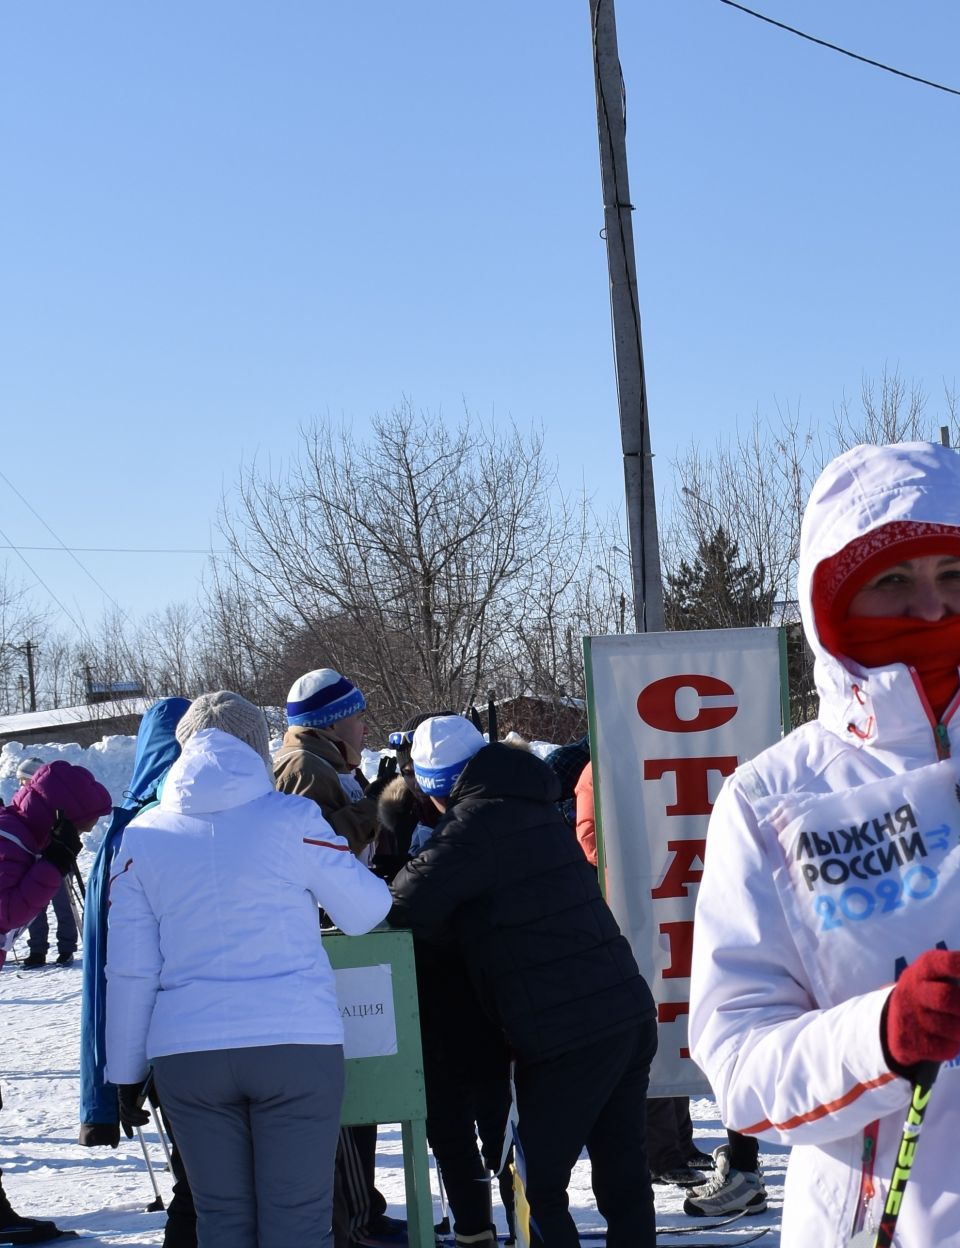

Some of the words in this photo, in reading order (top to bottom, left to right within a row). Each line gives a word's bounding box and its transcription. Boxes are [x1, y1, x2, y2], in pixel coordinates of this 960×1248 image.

[796, 803, 918, 861] ЛЫЖНЯ
[801, 832, 928, 891] РОССИИ
[814, 865, 938, 931] 2020
